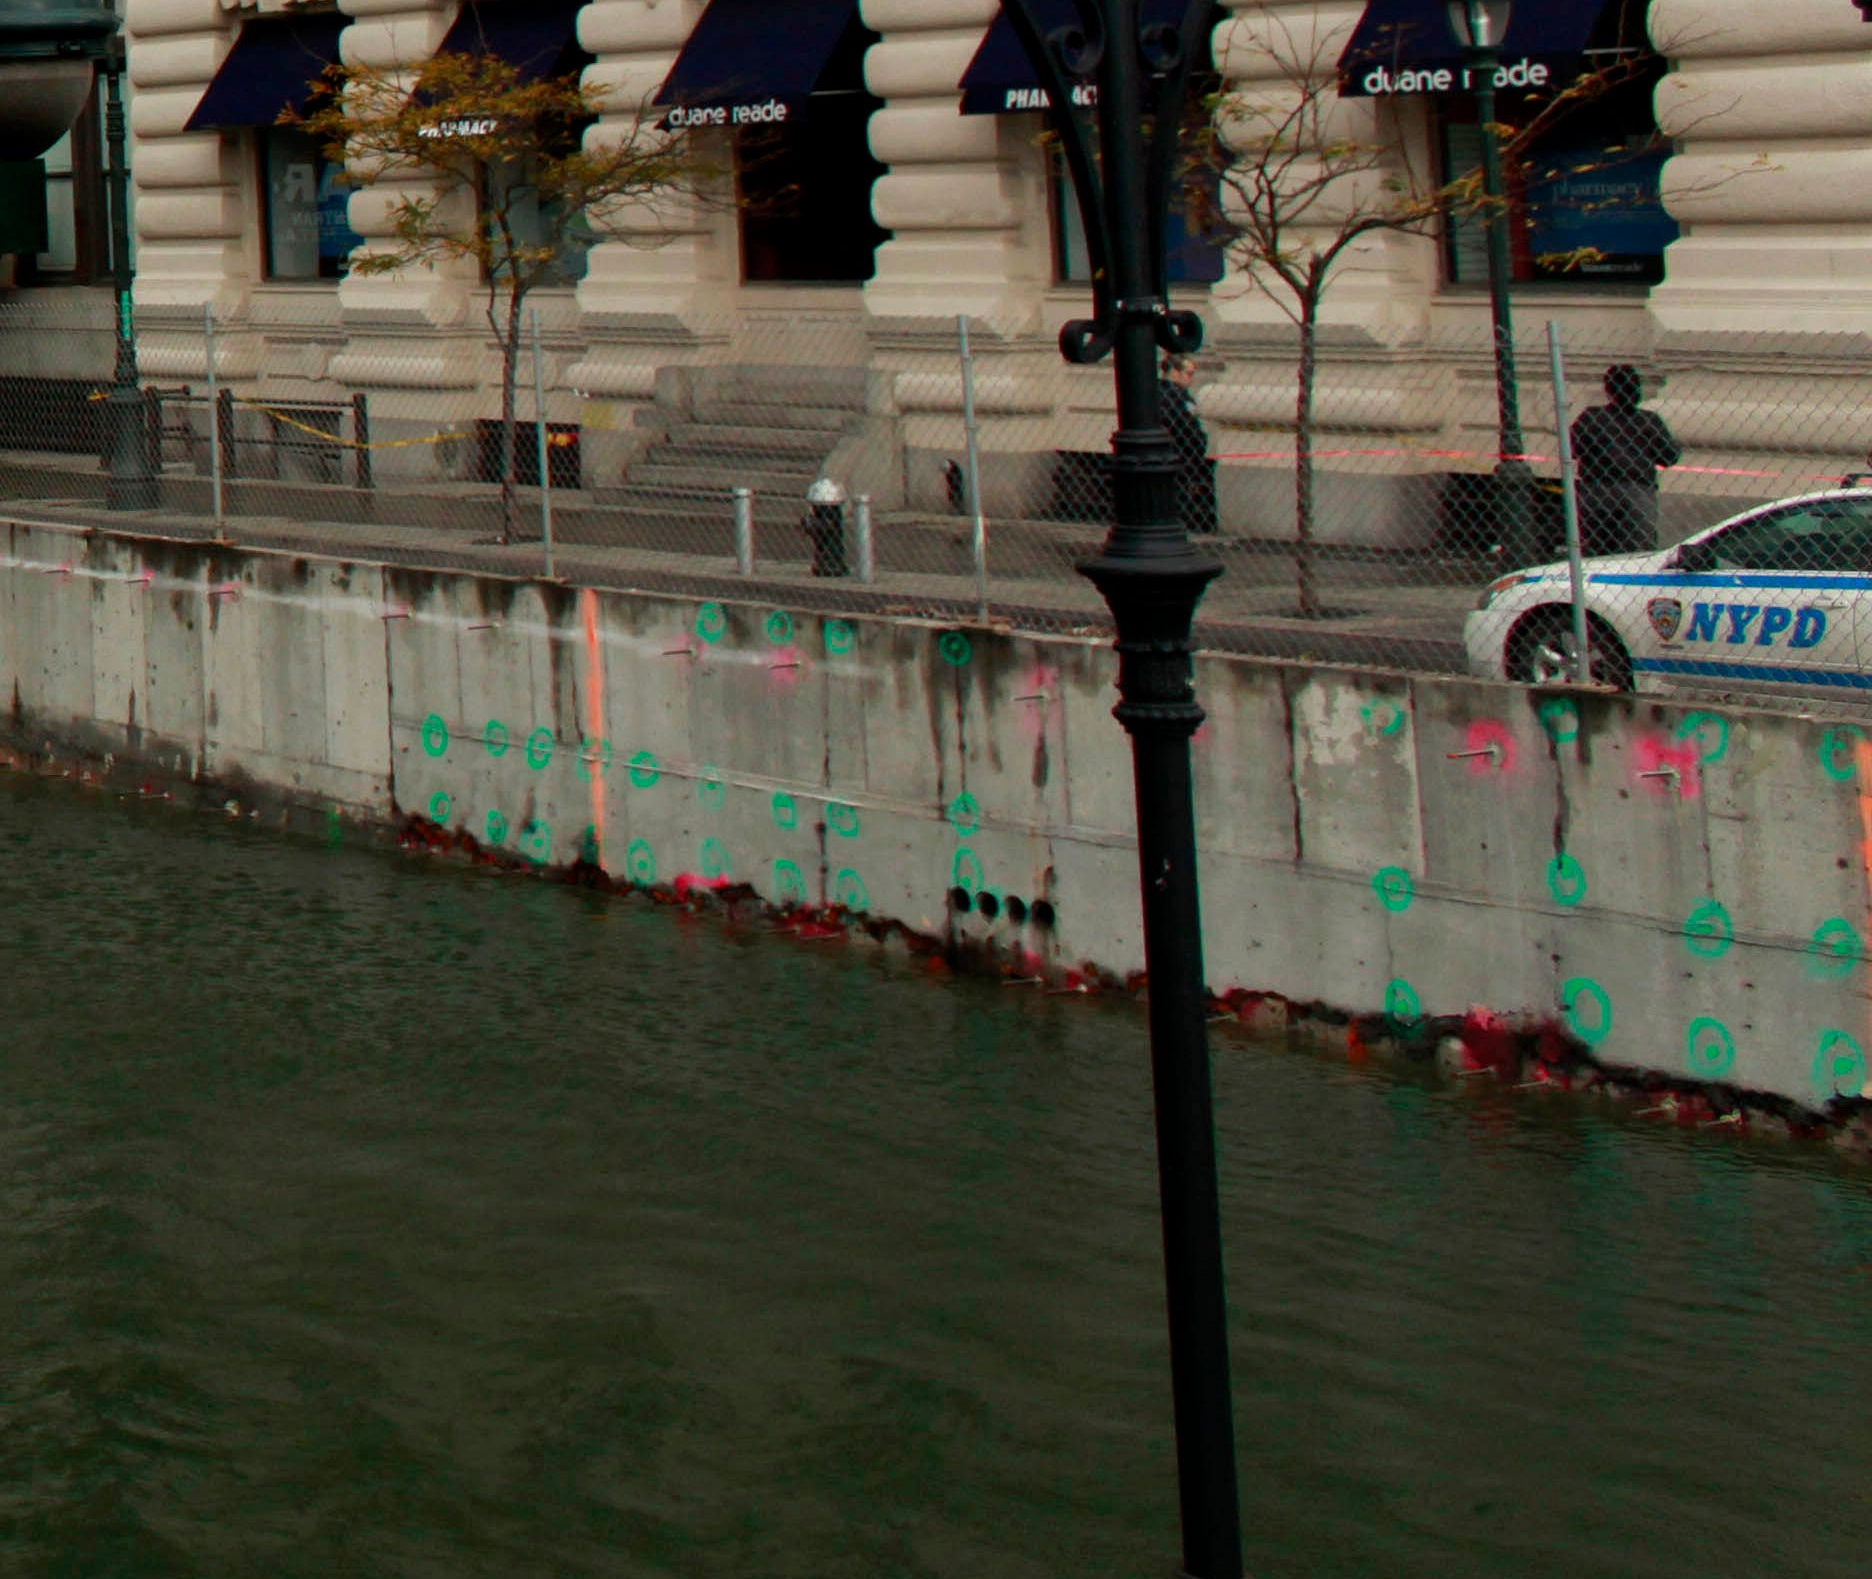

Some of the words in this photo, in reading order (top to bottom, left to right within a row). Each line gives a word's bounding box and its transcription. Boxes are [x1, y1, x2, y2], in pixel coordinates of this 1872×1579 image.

[1364, 66, 1452, 94] duane
[1463, 57, 1548, 89] rade
[668, 105, 728, 126] duane
[732, 98, 787, 124] reade
[1685, 602, 1827, 649] NYPD
